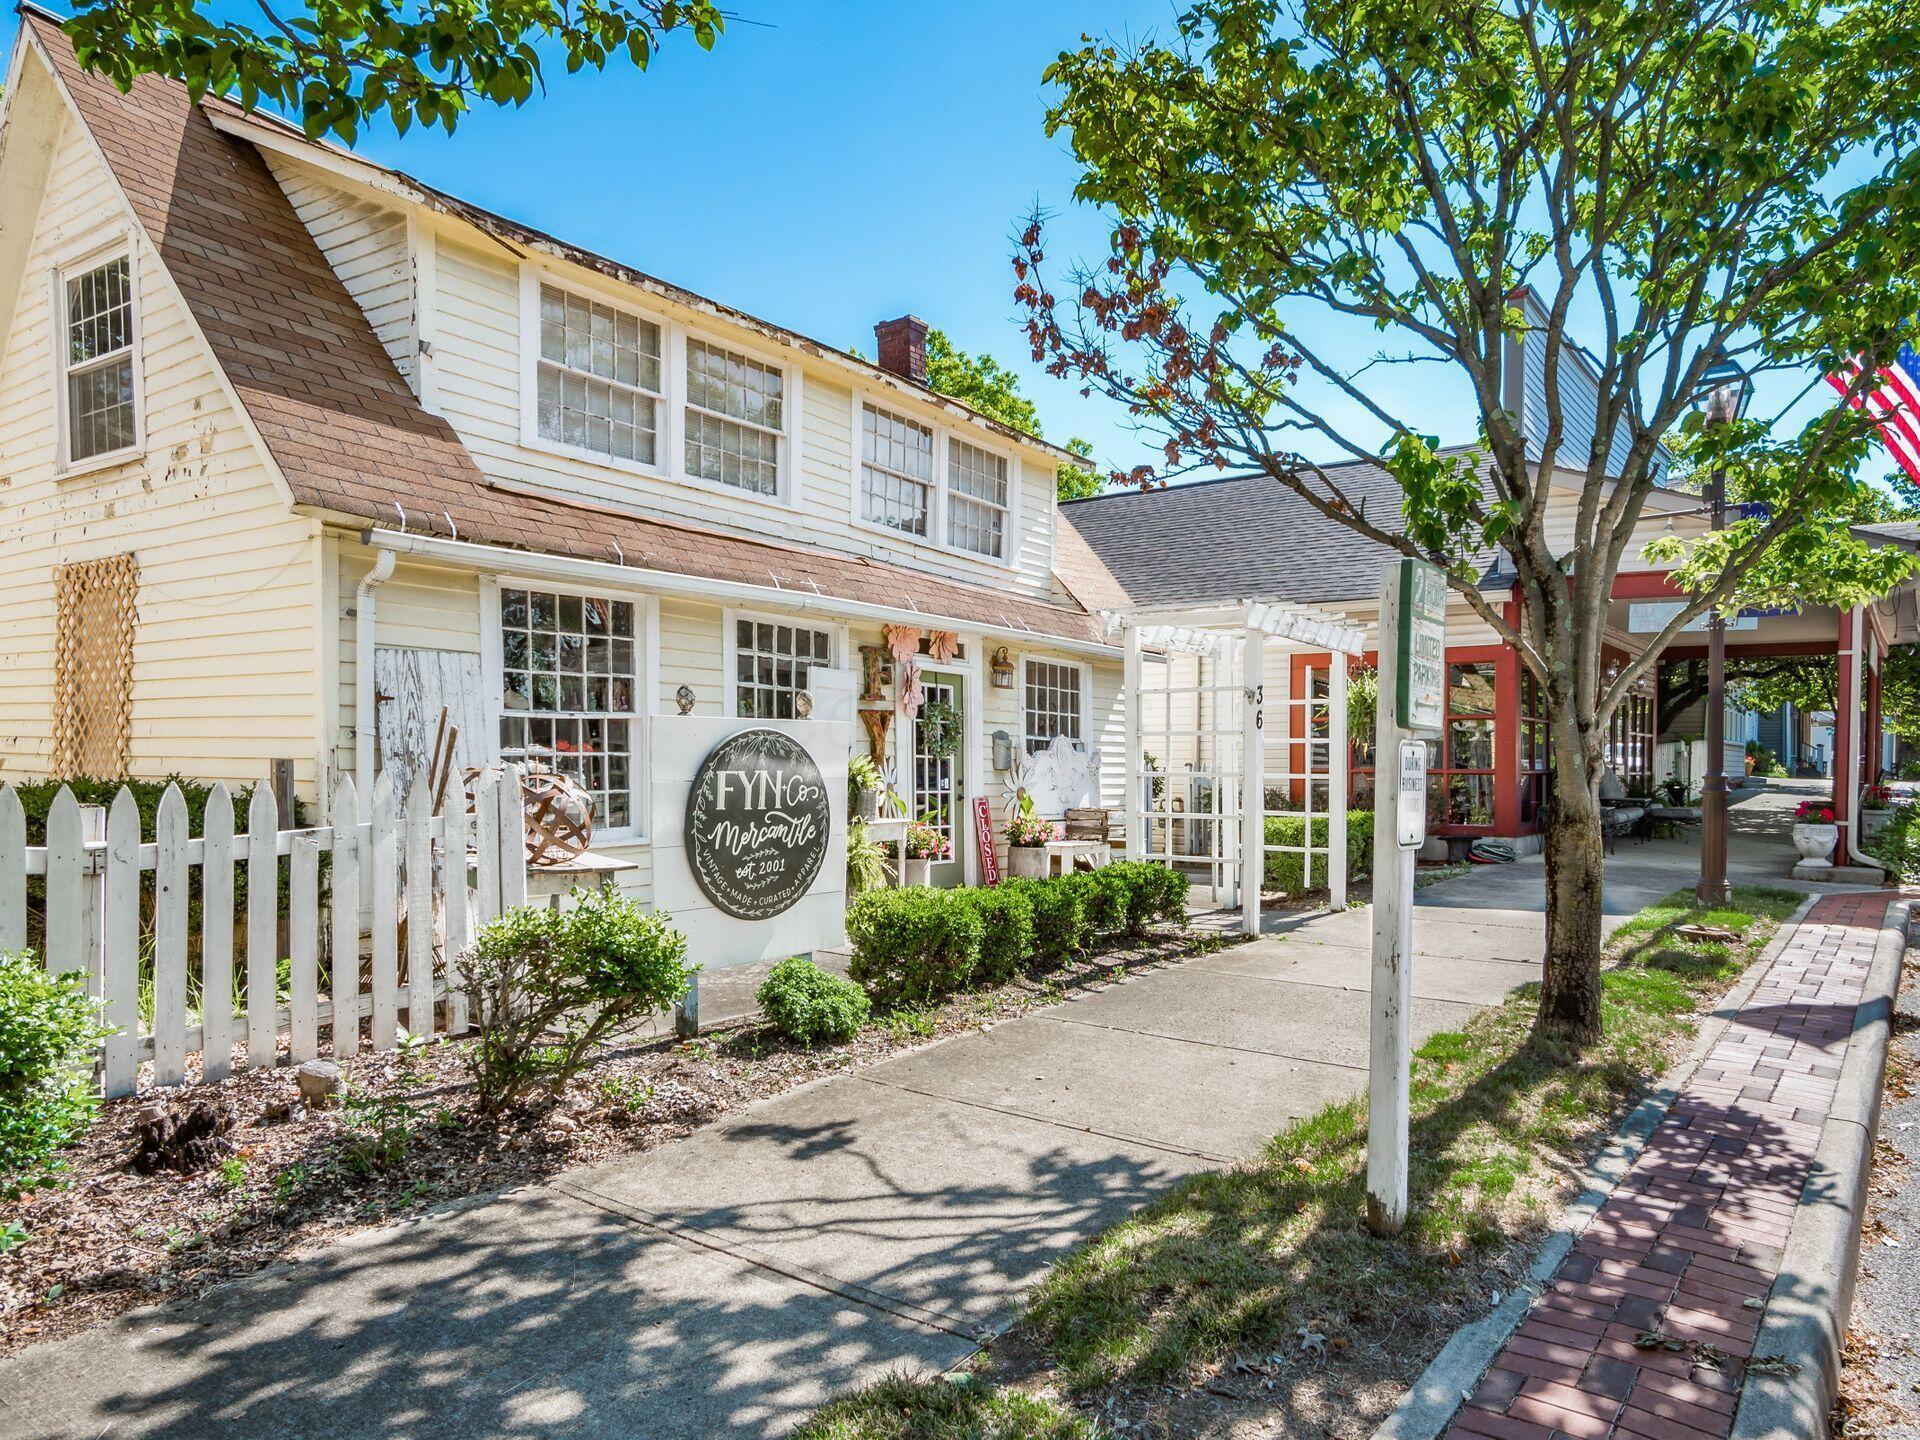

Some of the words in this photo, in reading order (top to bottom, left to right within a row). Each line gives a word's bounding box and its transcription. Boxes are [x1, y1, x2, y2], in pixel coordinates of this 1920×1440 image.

[1415, 632, 1440, 660] LIMITED
[1412, 662, 1441, 689] PARKING
[1256, 685, 1263, 729] 36
[1405, 757, 1421, 771] DURING
[1402, 777, 1423, 792] BUSINESS
[707, 811, 817, 856] Mercantile
[979, 805, 996, 881] CLOSED
[703, 848, 727, 890] VINTAGE
[730, 887, 753, 906] MADE
[758, 887, 792, 906] CURATED
[795, 846, 821, 886] APPAREL
[759, 858, 785, 875] 2001
